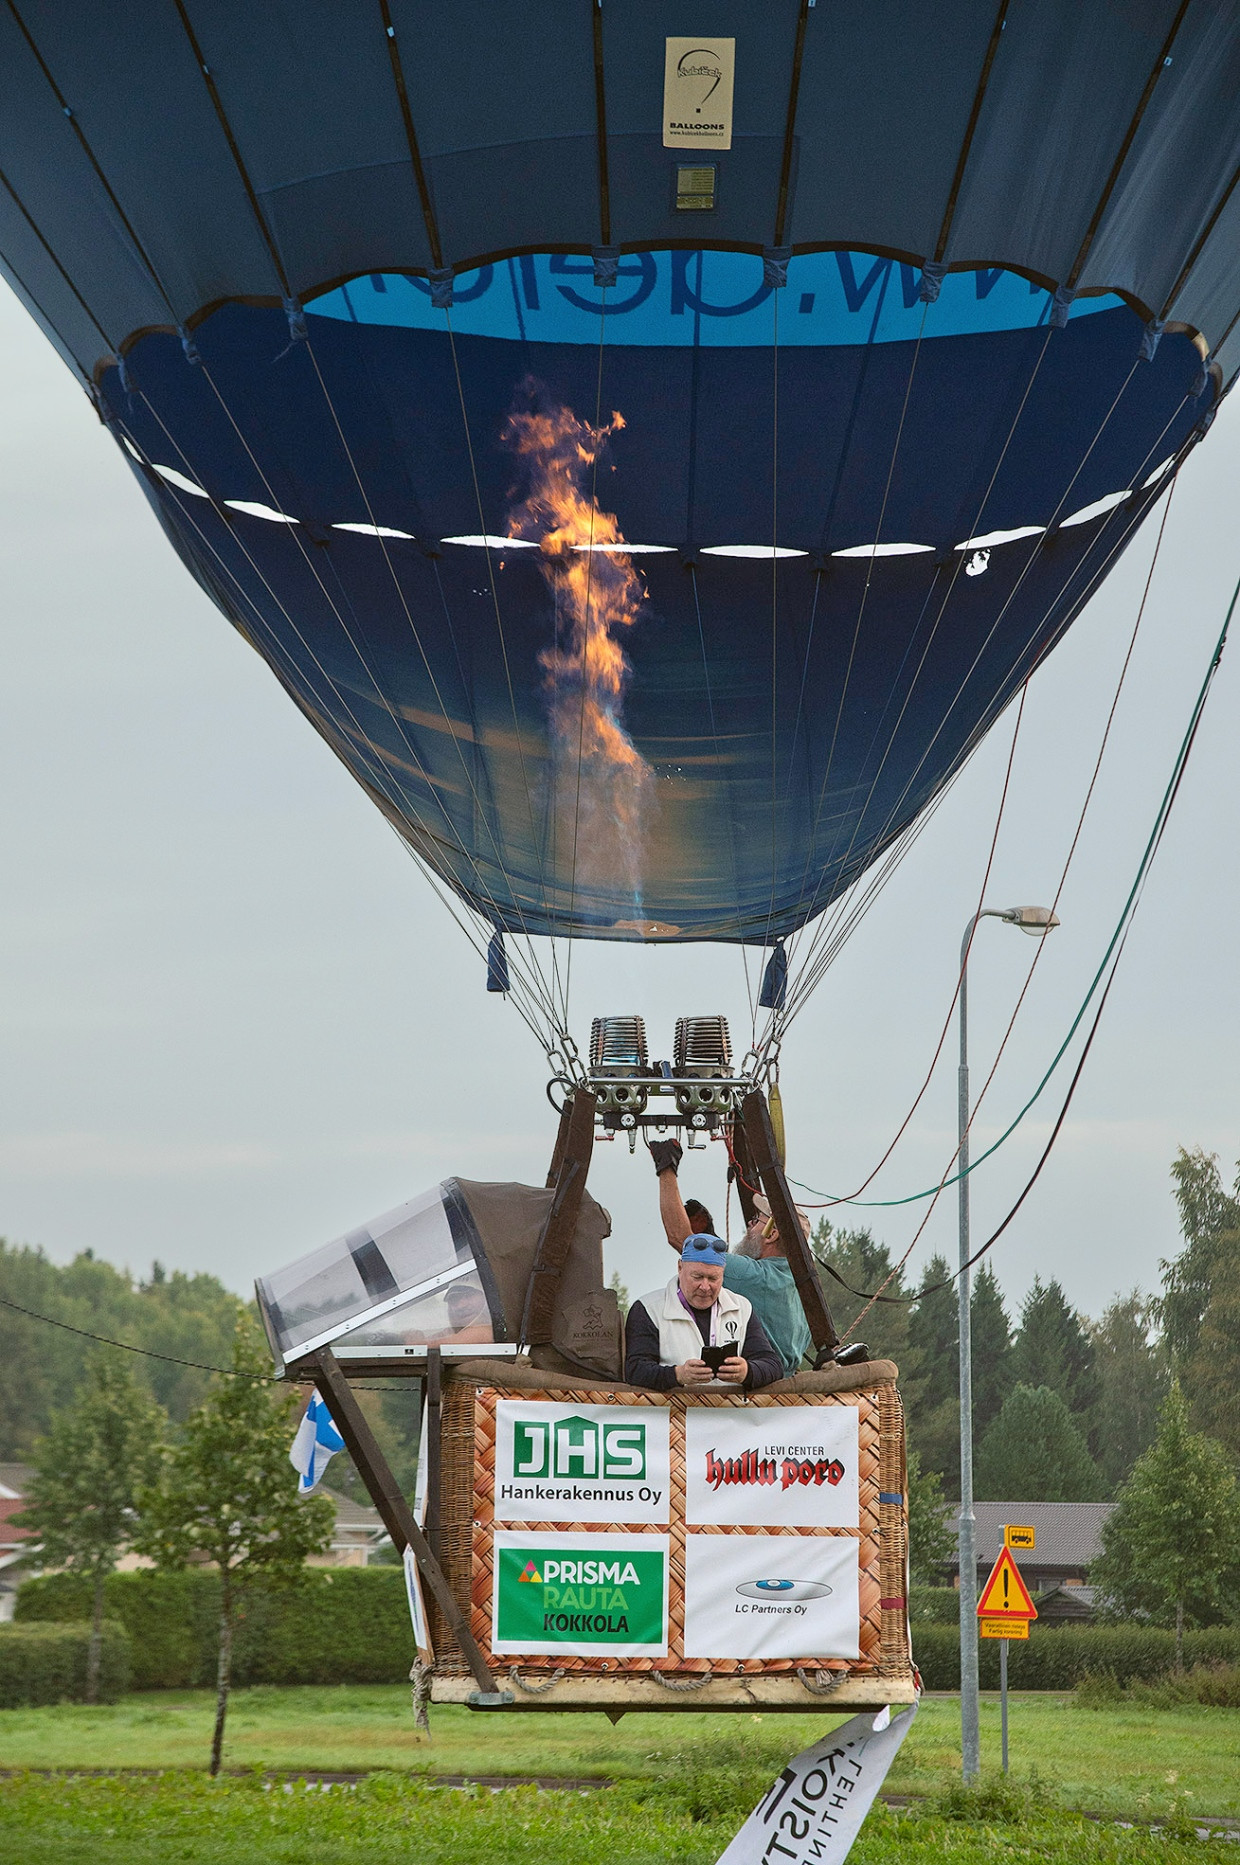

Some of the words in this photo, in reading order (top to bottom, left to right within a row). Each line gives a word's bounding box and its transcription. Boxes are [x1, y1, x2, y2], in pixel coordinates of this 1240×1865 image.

[670, 122, 725, 130] BALLOONS
[518, 1426, 643, 1476] JHS
[765, 1446, 785, 1456] LEVI
[788, 1446, 824, 1456] CENTER
[705, 1448, 778, 1491] hullu
[780, 1457, 845, 1491] poro
[501, 1485, 634, 1501] Hankerakennus
[638, 1487, 662, 1505] Oy
[543, 1560, 641, 1585] PRISMA
[543, 1587, 629, 1610] RAUTA
[735, 1604, 749, 1613] LC
[751, 1604, 792, 1613] Partners
[794, 1604, 808, 1615] Oy
[543, 1613, 629, 1633] KOKKOLA
